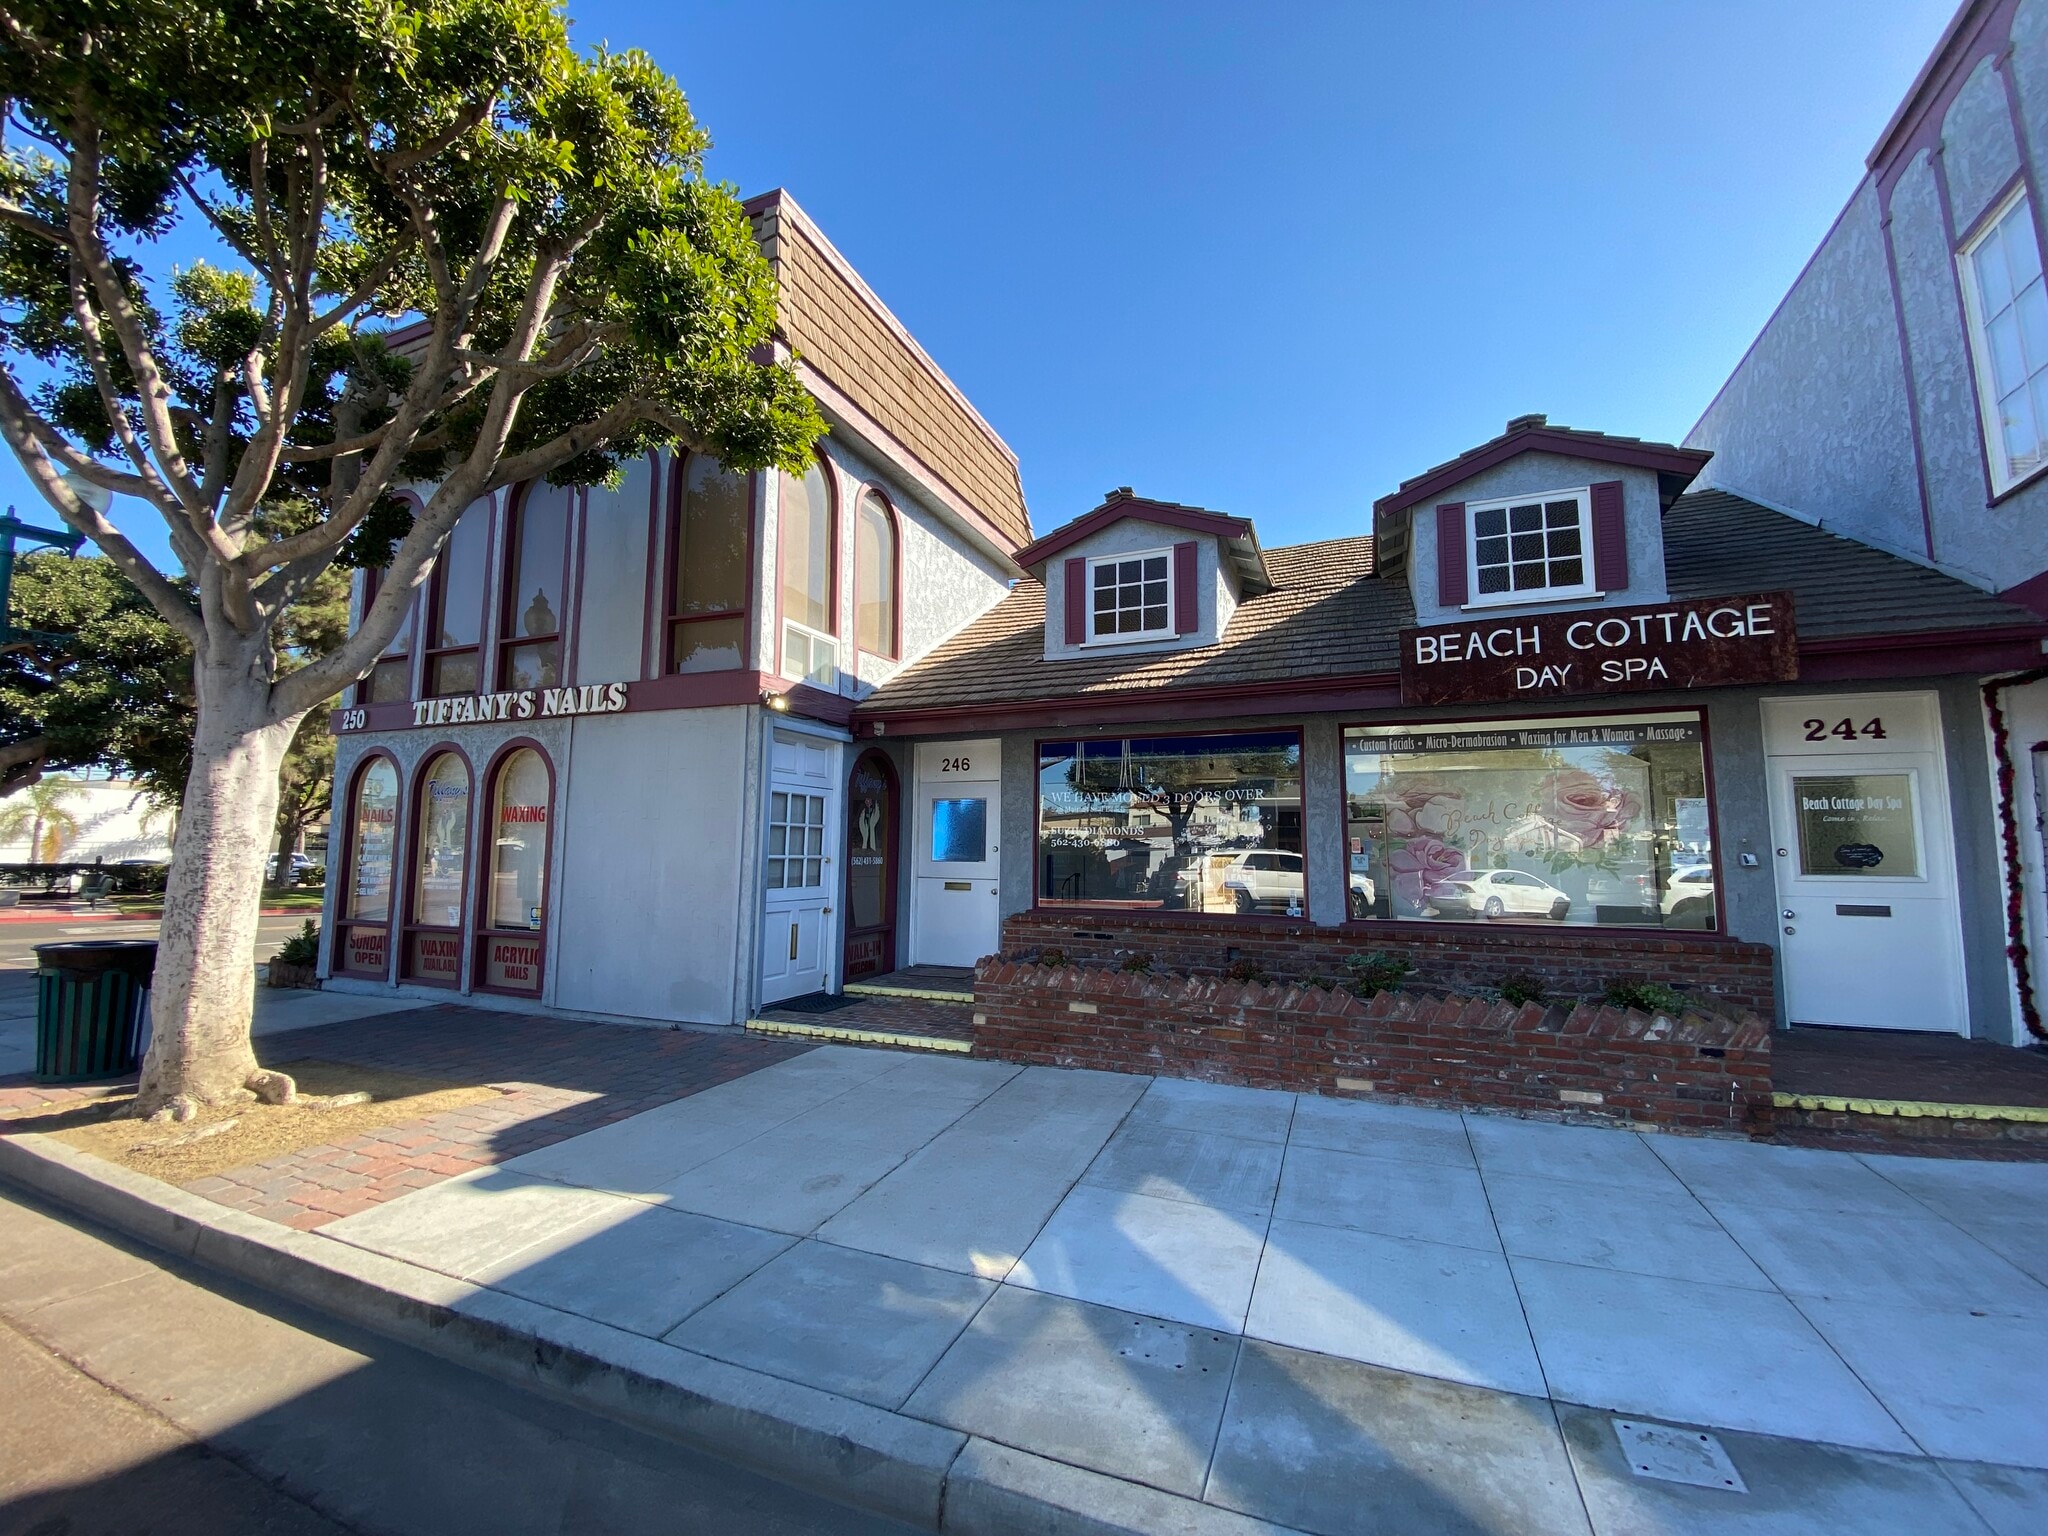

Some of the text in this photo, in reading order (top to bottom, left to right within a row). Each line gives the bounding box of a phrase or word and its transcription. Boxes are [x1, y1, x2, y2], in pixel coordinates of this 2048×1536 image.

[1415, 603, 1776, 665] BEACH COTTAGE
[1516, 656, 1669, 690] DAY SPA
[413, 682, 628, 726] TIFFANY'S NAILS
[342, 709, 366, 731] 250
[1803, 717, 1887, 742] 244
[1359, 726, 1686, 752] Custom Facials Micro-Dermabrasion Waxing for Men & Women Massage
[941, 758, 971, 772] 246
[1051, 792, 1071, 803] WE
[1074, 792, 1110, 803] HAVE
[1162, 794, 1171, 805] 3
[1174, 791, 1221, 804] DOORS
[1224, 788, 1265, 801] OVER
[1803, 796, 1829, 811] Beach
[1831, 795, 1864, 812] Cottage
[1867, 796, 1884, 812] Day
[362, 808, 393, 823] NAILS
[501, 806, 547, 823] WAXING
[1441, 800, 1501, 837] Beach
[355, 951, 382, 965] OPEN
[504, 965, 529, 981] NAILS
